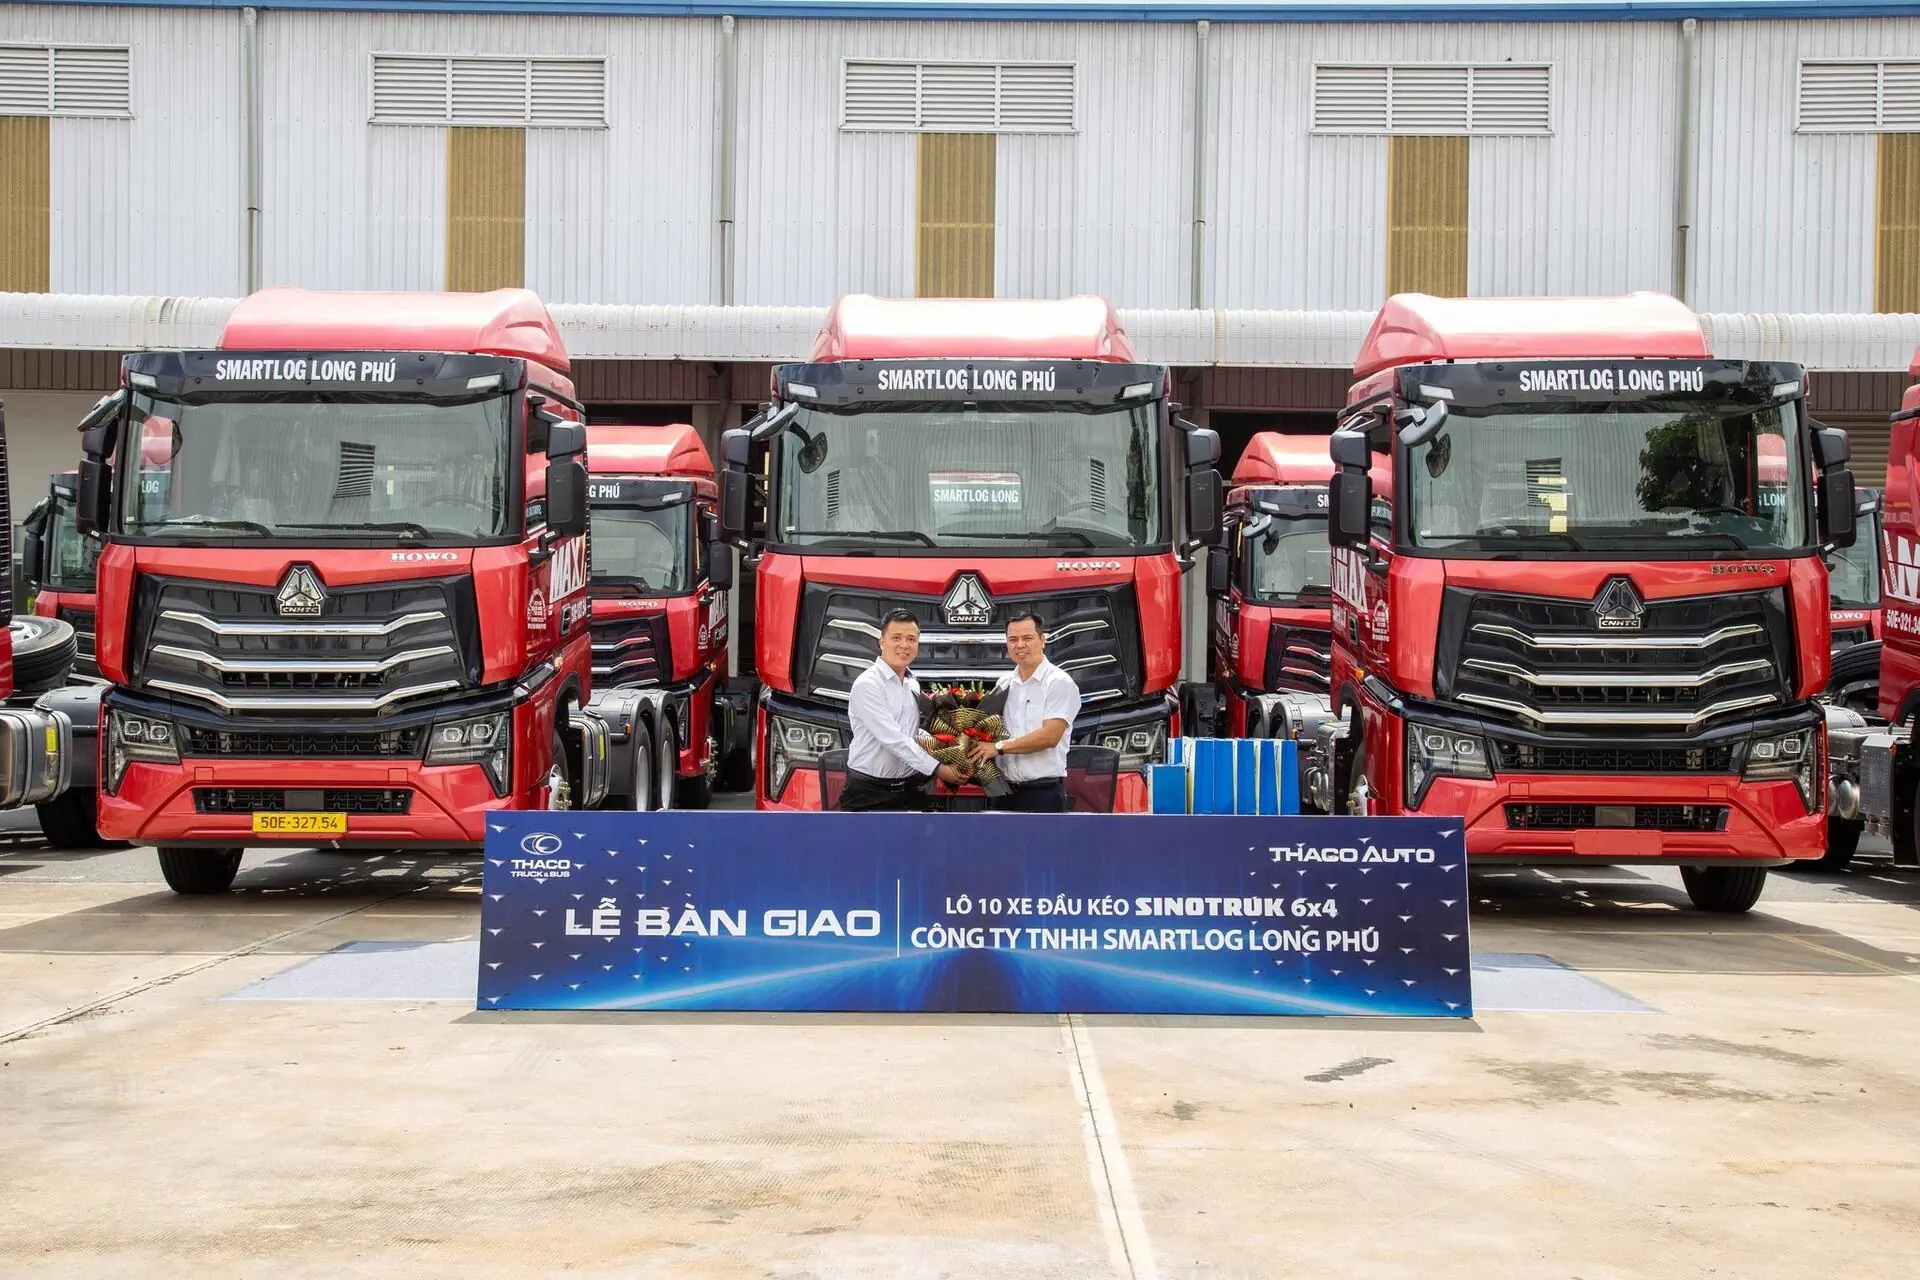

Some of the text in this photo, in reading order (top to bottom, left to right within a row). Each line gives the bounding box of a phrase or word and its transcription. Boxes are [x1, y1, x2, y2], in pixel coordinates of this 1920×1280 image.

[215, 358, 396, 383] SMARTLOG LONG PHÚ
[878, 366, 1056, 392] SMARTLOG LONG PHÚ
[1519, 367, 1704, 392] SMARTLOG LONG PHÚ
[599, 483, 620, 498] PHÚ
[934, 489, 1019, 502] SMARTLOG LONG
[390, 552, 458, 562] HOWO
[1056, 561, 1121, 571] HOWO
[1711, 564, 1776, 574] HOWO
[950, 615, 986, 623] CNHTC
[1601, 619, 1638, 627] CNHTC
[261, 816, 338, 829] 50E-327.54
[1269, 846, 1435, 863] THACO AUTO
[511, 859, 571, 870] THACO
[946, 893, 1338, 917] LÔ 10 XE ĐẦU KÉO SINOTRUK 6x4
[565, 897, 881, 937] LỄ BÀN GIAO
[911, 922, 1380, 953] CÔNG TY TNHH SMARTLOG LONG PHÚ
